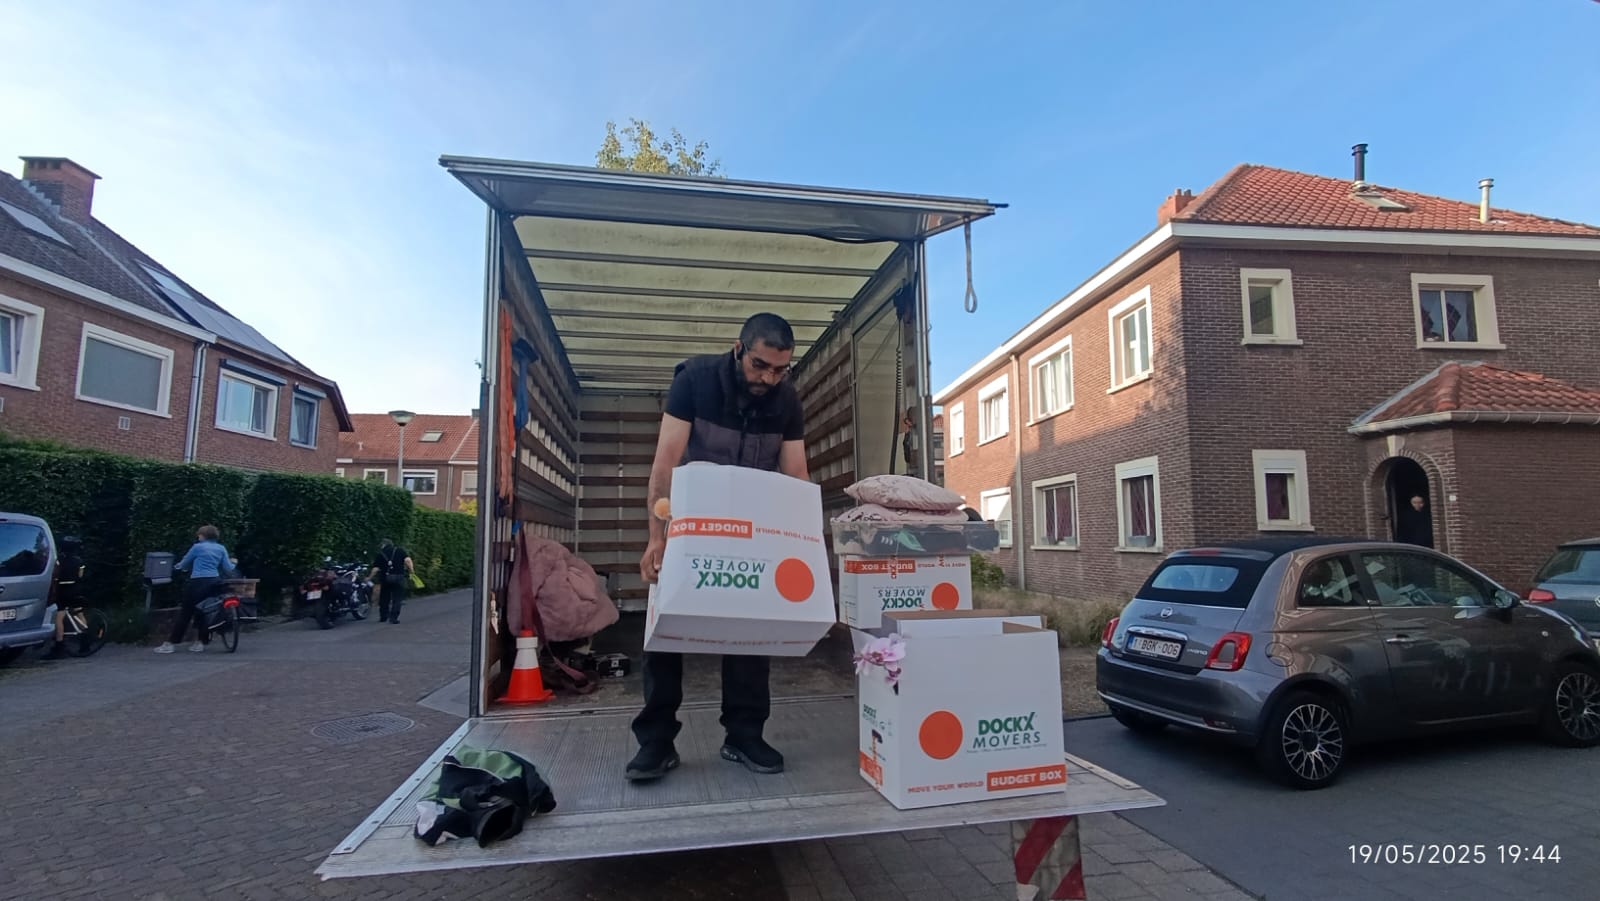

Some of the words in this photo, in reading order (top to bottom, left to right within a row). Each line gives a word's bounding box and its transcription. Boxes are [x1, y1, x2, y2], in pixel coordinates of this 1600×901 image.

[672, 522, 696, 533] BOX
[700, 523, 748, 534] BUDGET
[691, 558, 766, 573] MOVERS
[696, 571, 759, 589] DOCKX
[878, 588, 926, 598] MOVERS
[881, 597, 922, 610] DOCKX
[978, 711, 1036, 735] DOCKX
[972, 731, 1041, 749] MOVERS
[990, 773, 1037, 786] BUDGET
[1039, 770, 1062, 781] BOX
